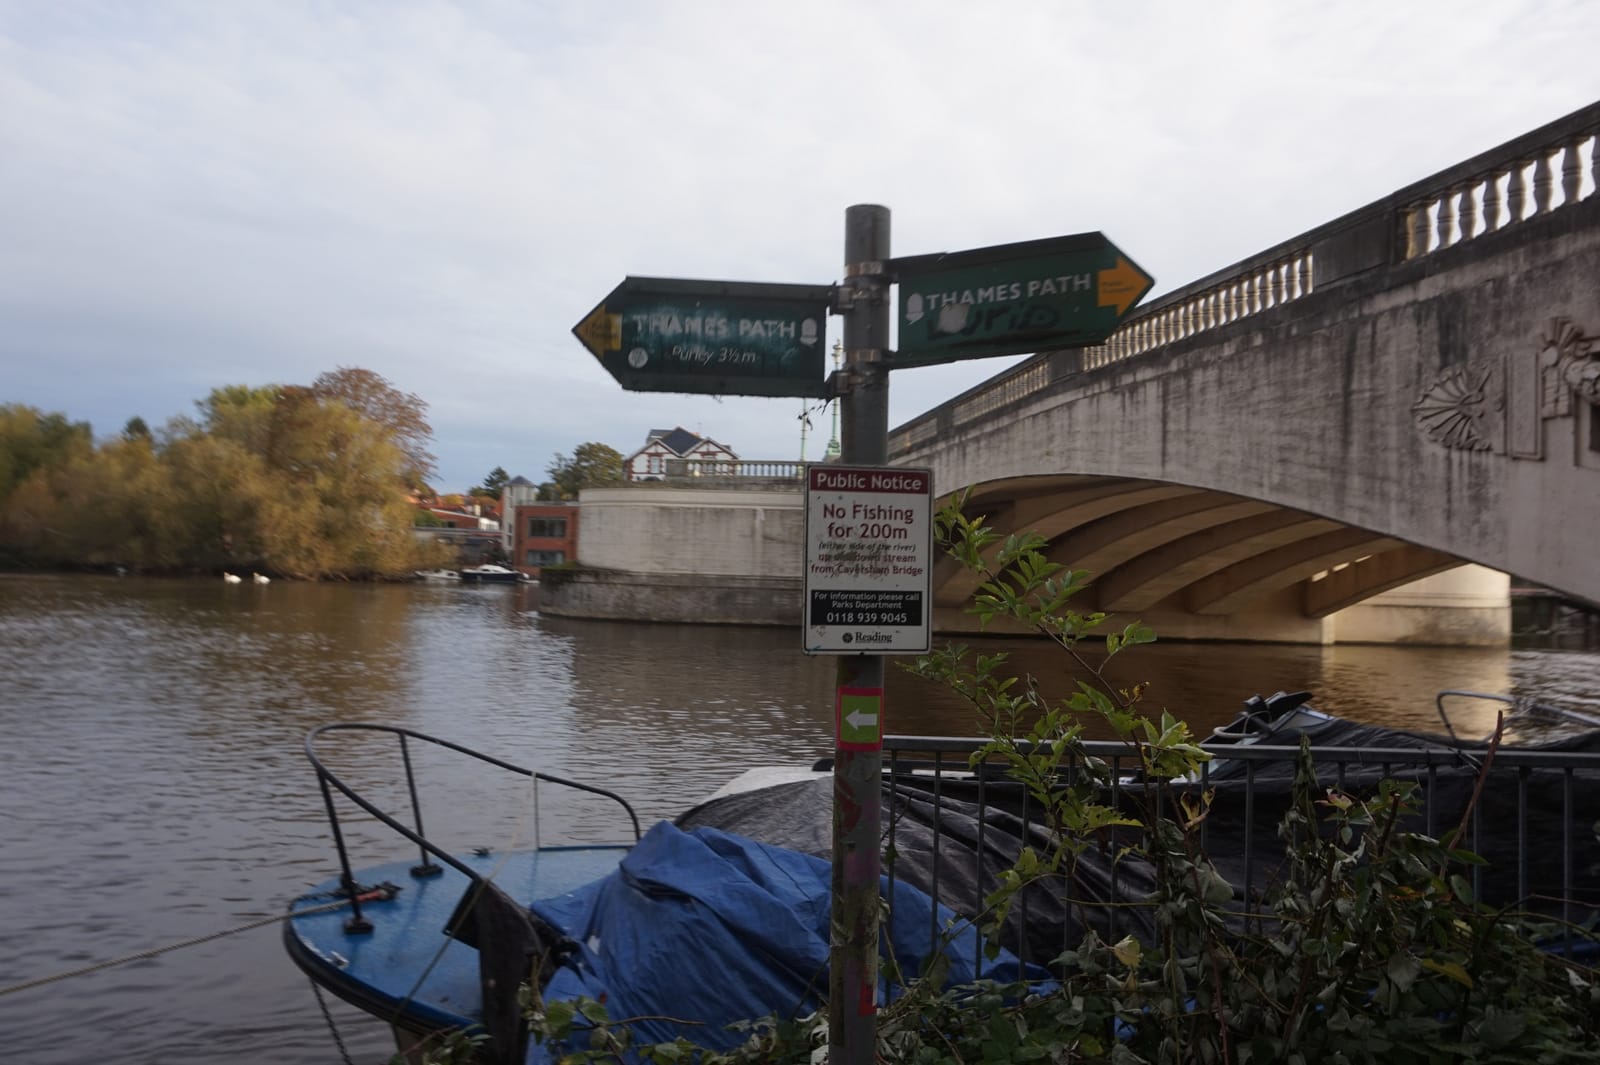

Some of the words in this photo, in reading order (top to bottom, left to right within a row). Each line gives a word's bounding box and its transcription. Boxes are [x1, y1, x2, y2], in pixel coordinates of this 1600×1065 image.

[926, 282, 1021, 310] THAMES
[1027, 273, 1092, 298] PATH
[632, 313, 729, 338] THAMES
[739, 319, 796, 338] PATH
[817, 473, 866, 489] Public
[871, 475, 922, 490] Notice
[823, 503, 846, 520] No
[852, 504, 914, 525] Fishing
[828, 522, 854, 538] for
[860, 523, 908, 539] 200m
[892, 565, 923, 577] Bridge
[832, 600, 854, 609] Parks
[855, 600, 902, 610] Department
[826, 612, 854, 624] 0118
[857, 612, 878, 624] 939
[880, 612, 908, 624] 9045
